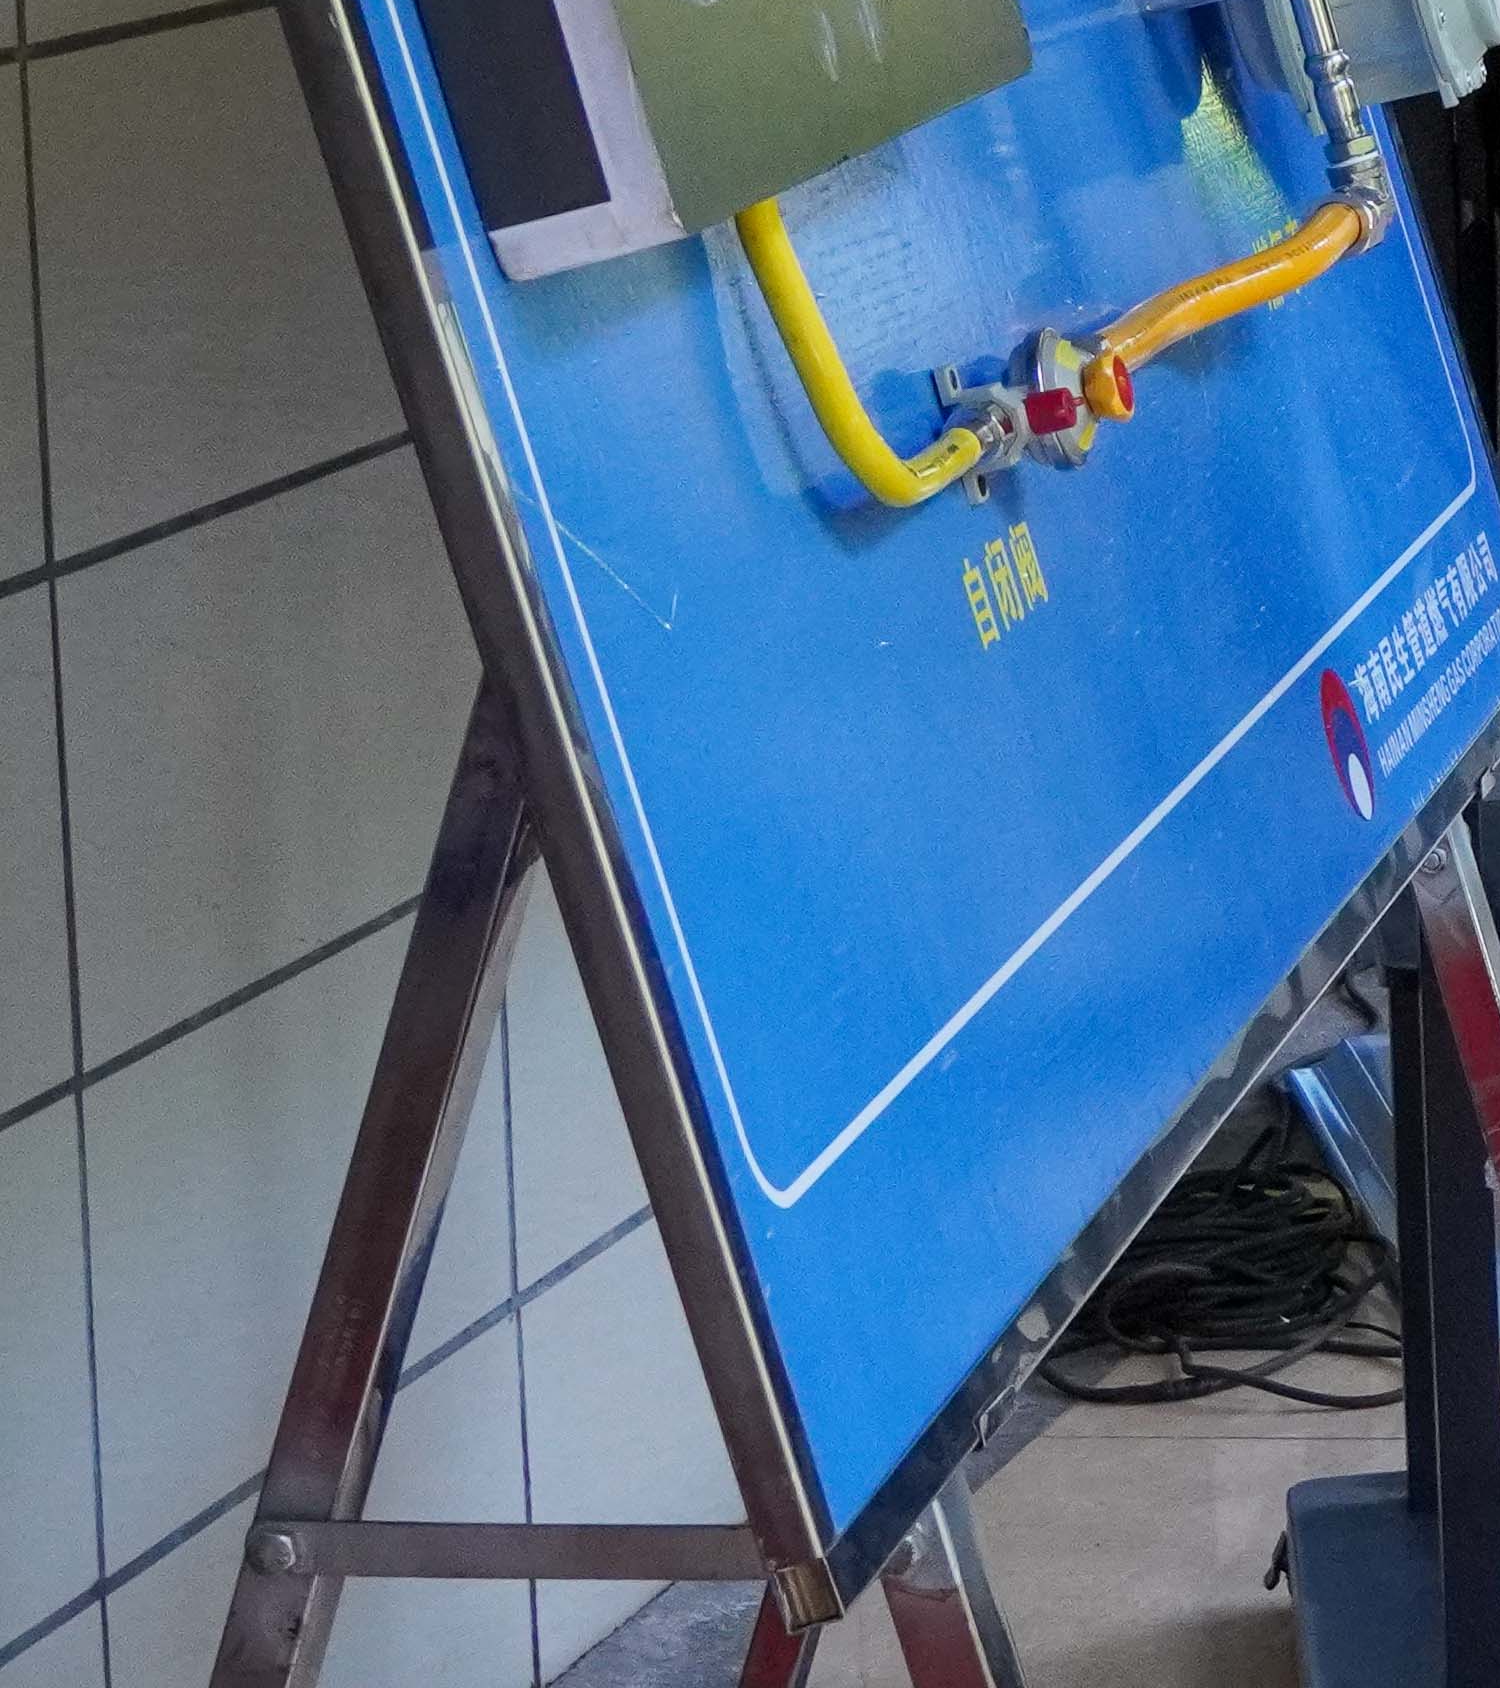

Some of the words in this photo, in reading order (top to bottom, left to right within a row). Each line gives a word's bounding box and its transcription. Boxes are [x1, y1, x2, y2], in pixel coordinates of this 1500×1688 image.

[962, 520, 1049, 651] 自闭阀
[1354, 529, 1499, 725] 海南民生管道燃气有限公司
[1445, 656, 1466, 696] GAS
